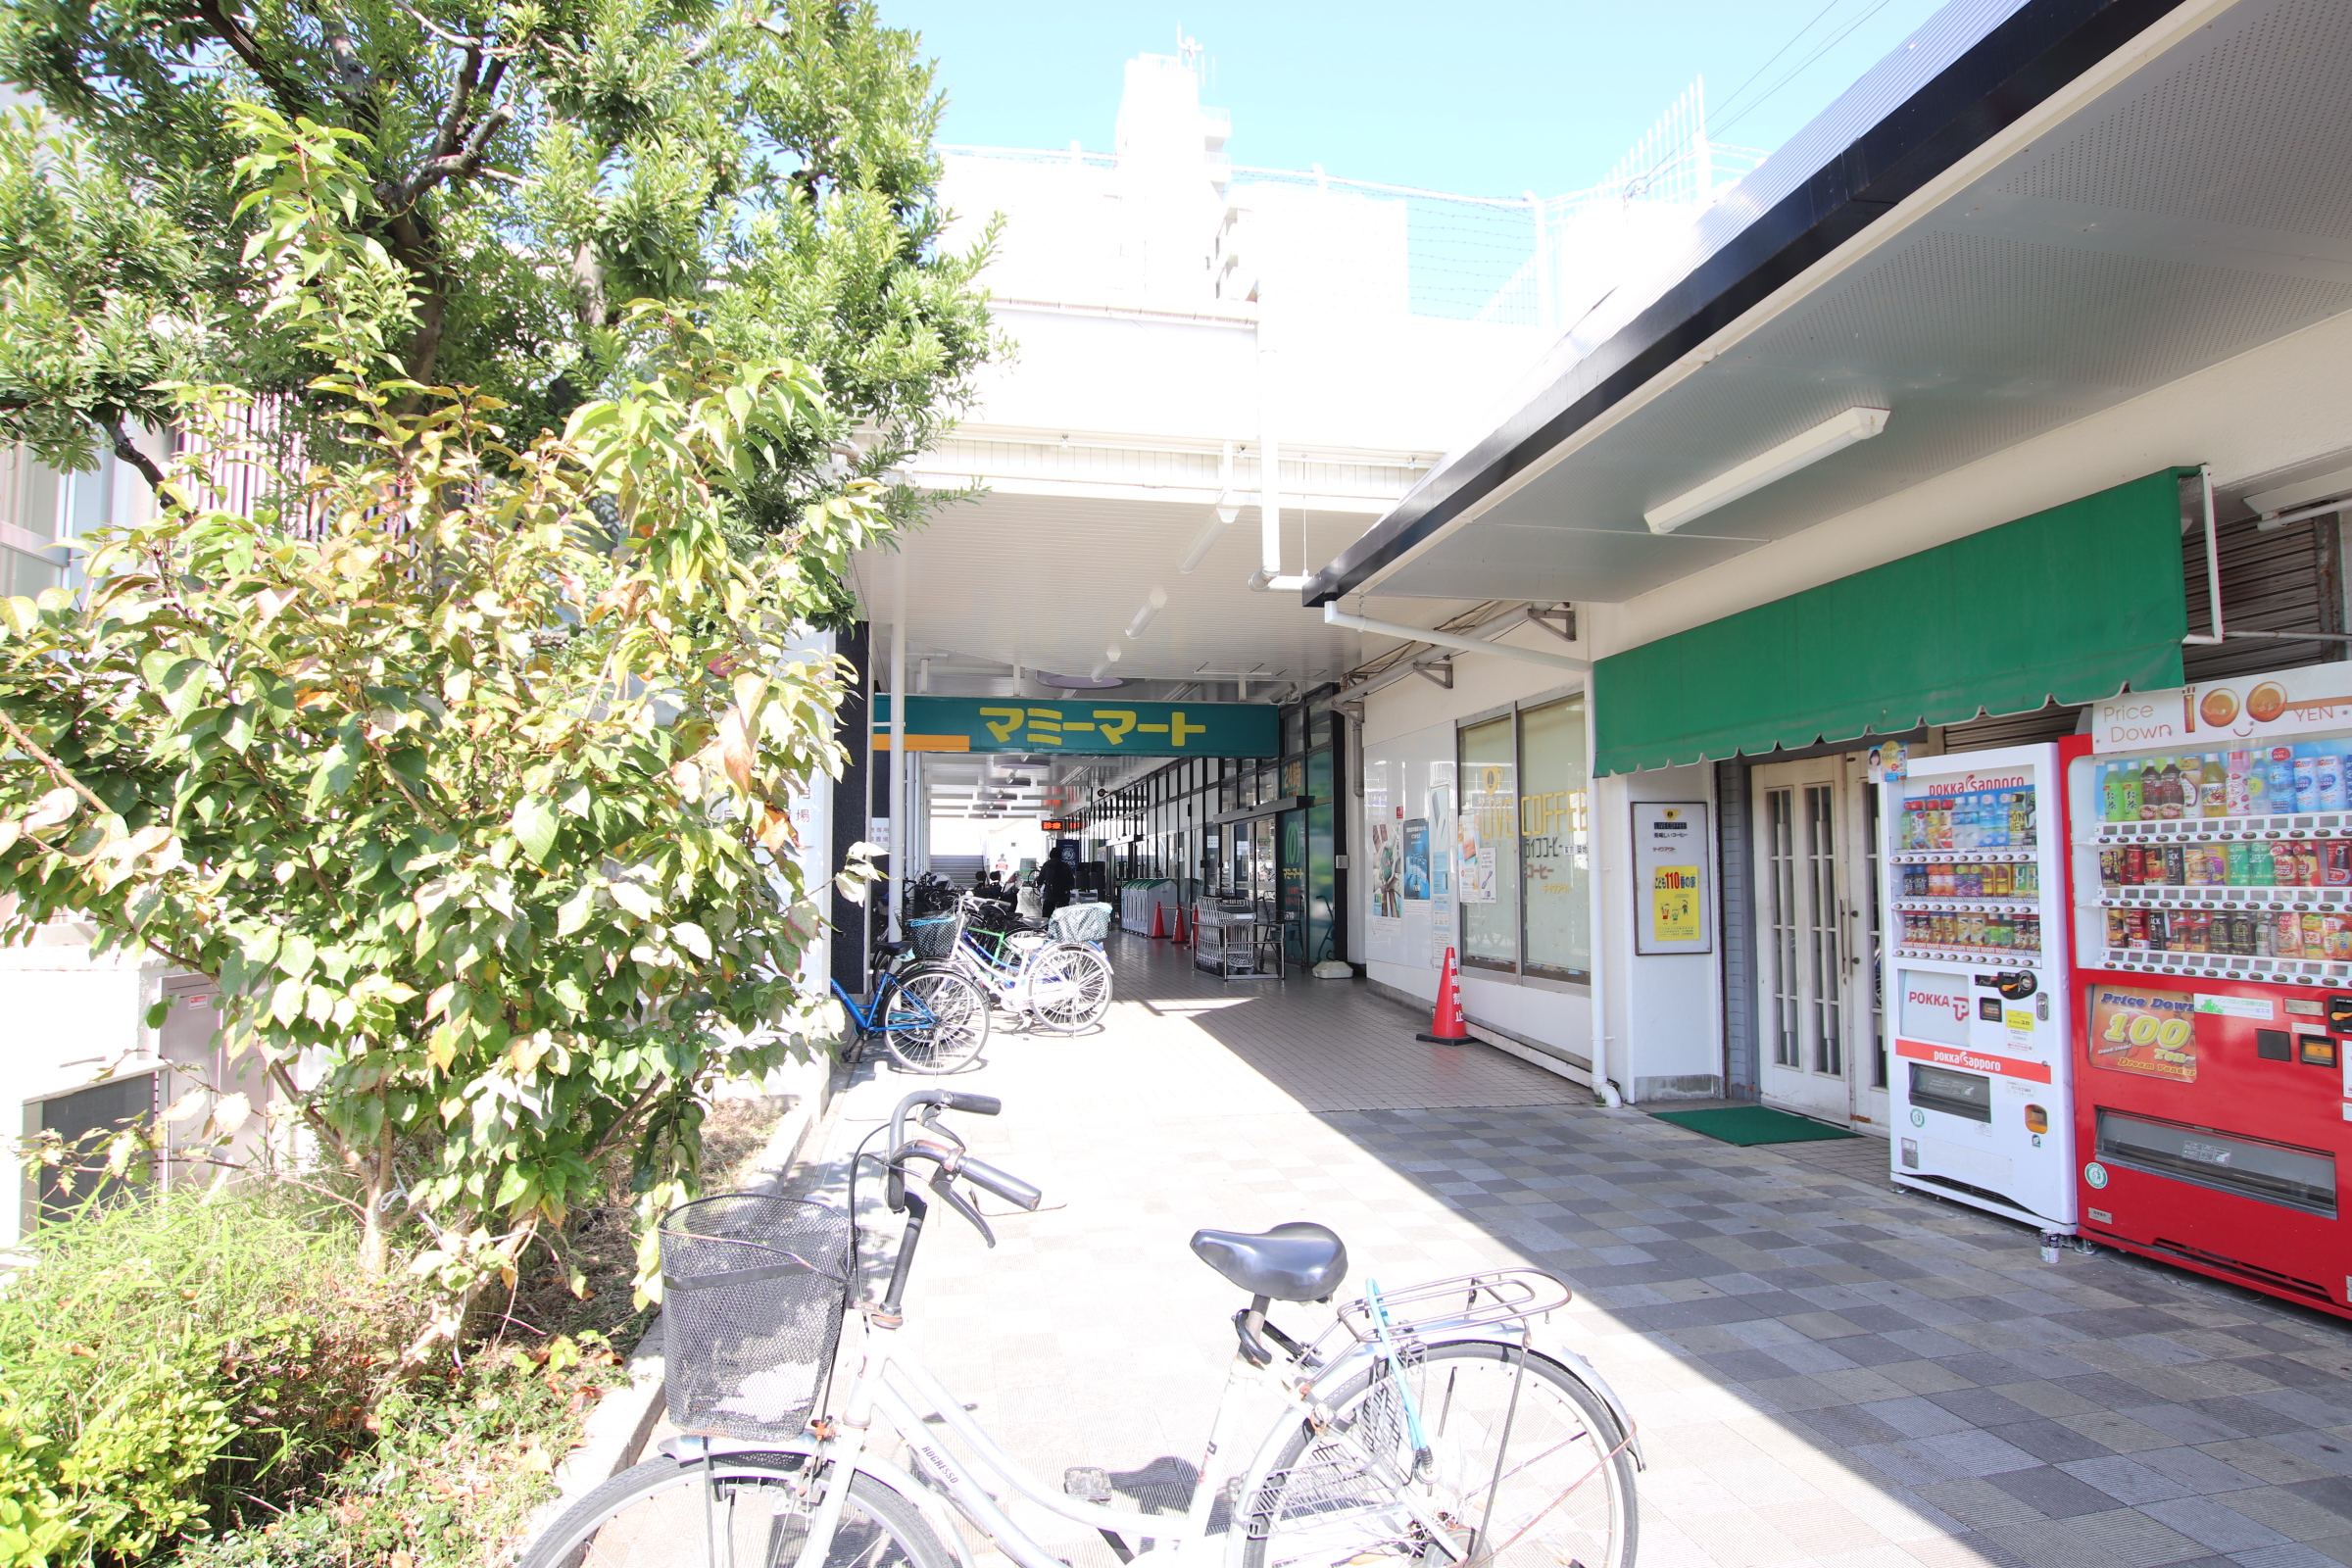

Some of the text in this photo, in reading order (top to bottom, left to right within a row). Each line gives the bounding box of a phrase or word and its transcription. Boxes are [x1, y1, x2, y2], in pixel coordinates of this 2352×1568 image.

[2103, 704, 2154, 723] Price
[2182, 681, 2334, 734] 100 YEN
[980, 707, 1206, 747] マミーマート
[2111, 723, 2172, 743] Down
[2107, 792, 2117, 809] お茶
[2127, 791, 2136, 809] お茶
[1481, 787, 1588, 839] LIVE COFFEE
[1283, 867, 1304, 880] マミーマート
[1655, 871, 1696, 889] こども110番の家
[1448, 957, 1464, 1022] 駐車禁止
[1909, 991, 1950, 1007] POKKA
[2100, 992, 2146, 1007] Price
[2104, 1012, 2192, 1051] 100
[1934, 1051, 2001, 1071] pokka sapporo
[2118, 1057, 2197, 1076] Dream Vender
